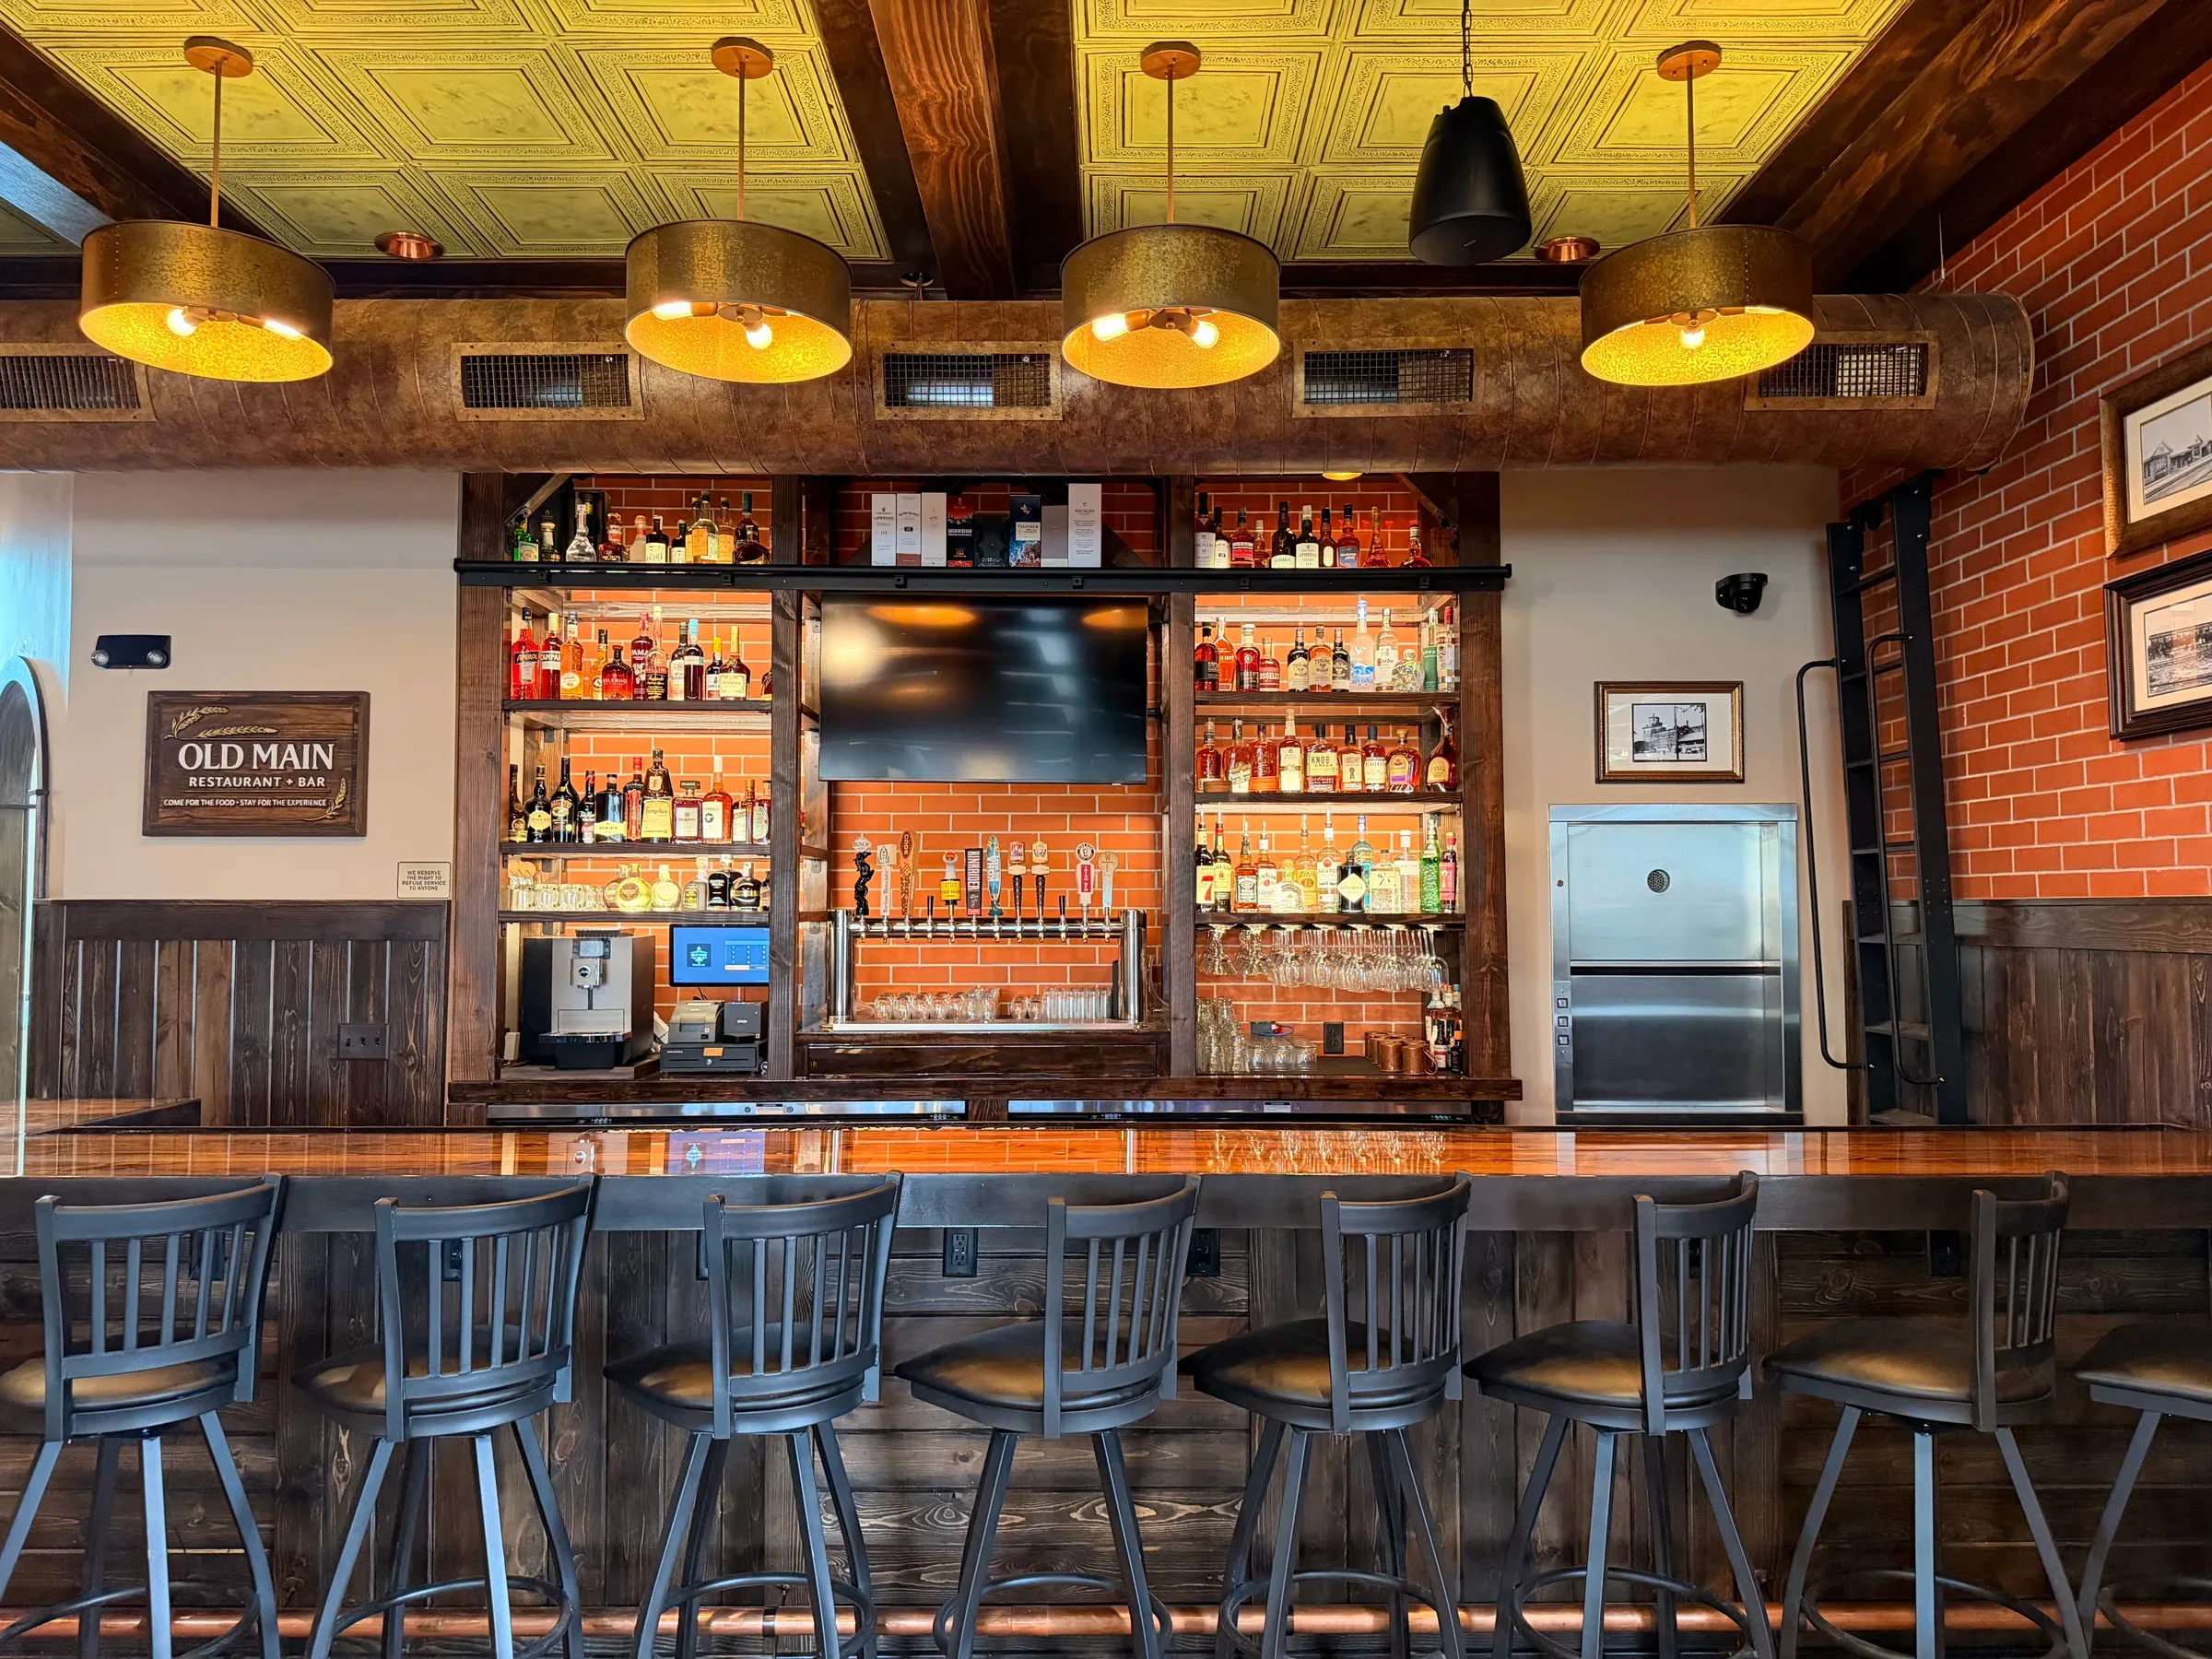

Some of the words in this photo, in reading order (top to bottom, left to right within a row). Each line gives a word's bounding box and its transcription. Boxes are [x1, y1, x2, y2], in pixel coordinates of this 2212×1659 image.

[178, 743, 244, 771] OLD
[252, 743, 335, 770] MAIN
[1311, 756, 1330, 764] KNOB
[189, 776, 282, 787] RESTAURANT
[298, 776, 325, 787] BAR
[1200, 875, 1214, 901] 7
